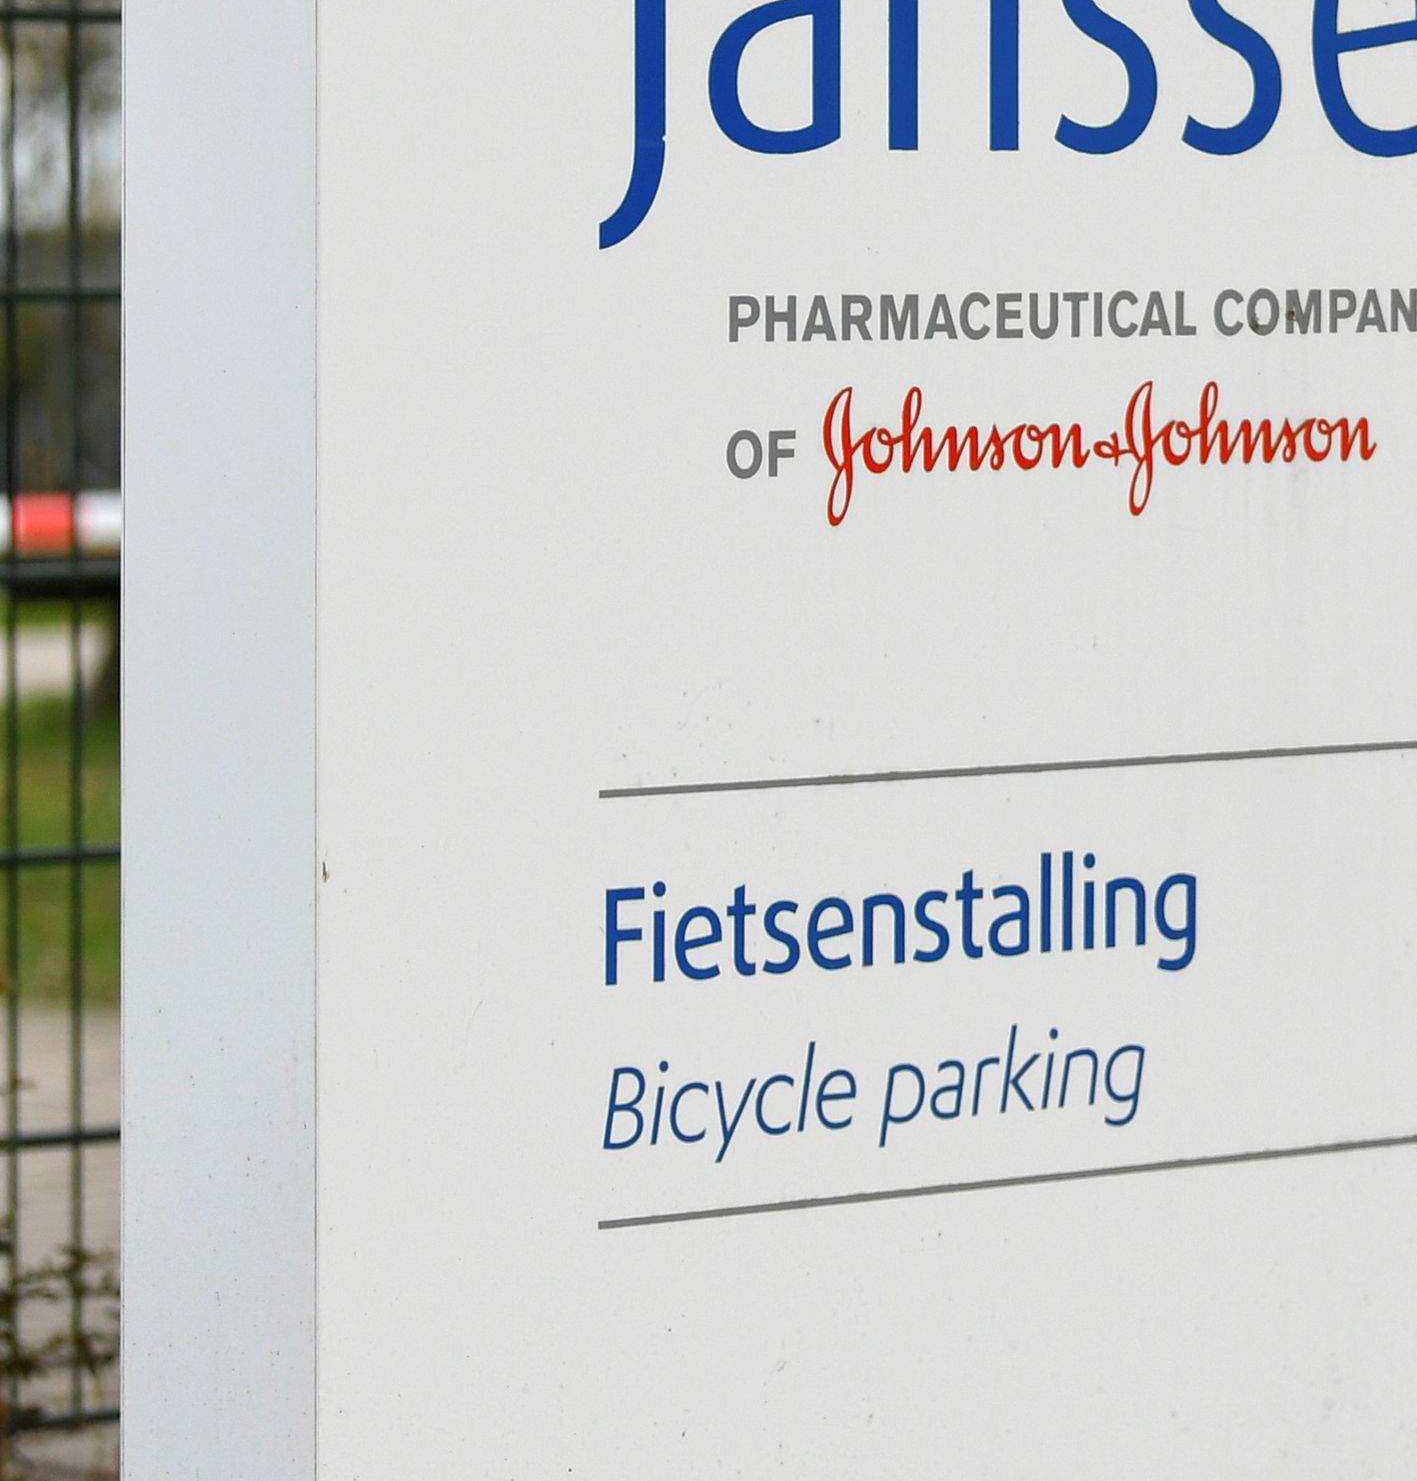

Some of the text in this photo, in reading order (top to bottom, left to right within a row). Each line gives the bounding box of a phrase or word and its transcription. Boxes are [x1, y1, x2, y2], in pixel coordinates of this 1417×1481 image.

[727, 289, 1198, 344] PHARMACEUTICAL
[725, 427, 798, 481] OF
[603, 849, 1199, 988] Fietsenstalling
[601, 1023, 1148, 1166] Bicycle parking
